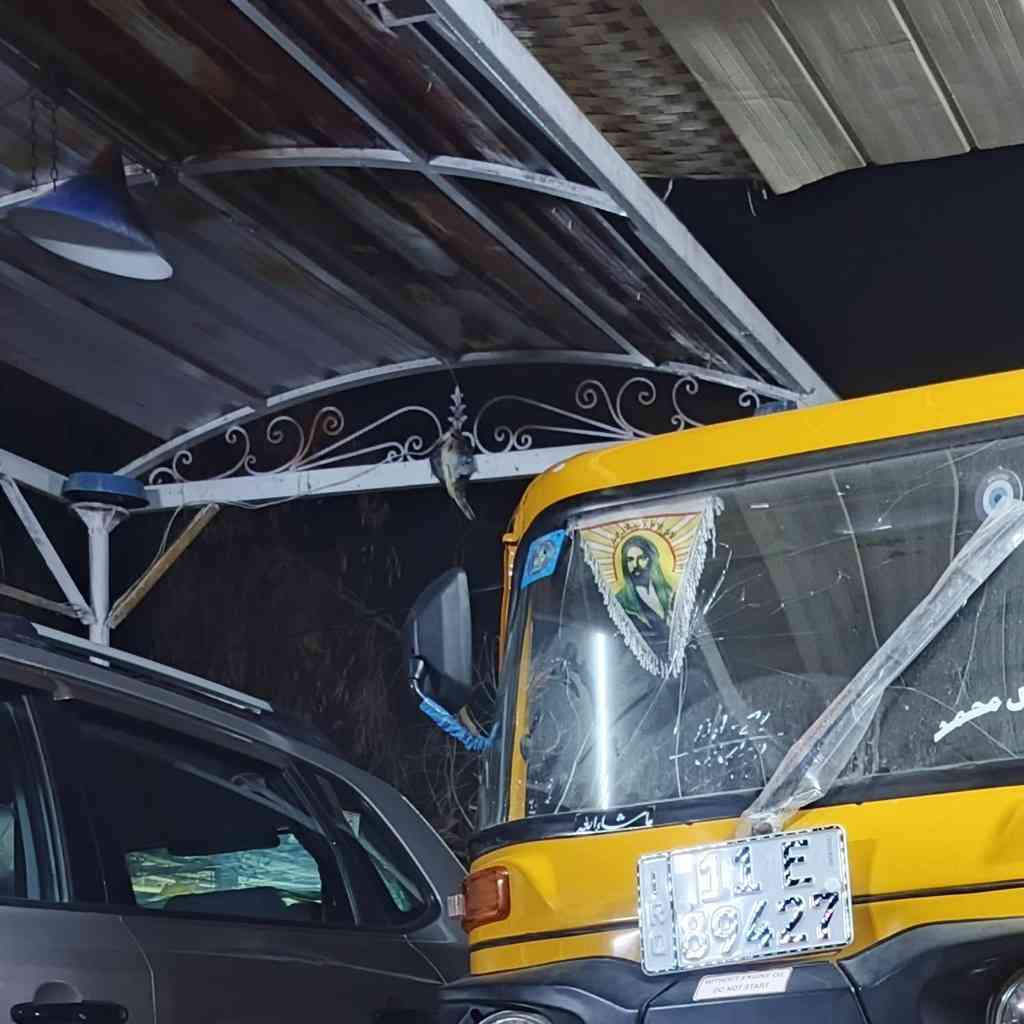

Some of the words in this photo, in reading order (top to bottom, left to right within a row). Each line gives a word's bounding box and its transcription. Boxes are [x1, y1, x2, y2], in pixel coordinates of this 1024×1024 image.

[933, 696, 1002, 743] محمد
[782, 839, 814, 887] E
[679, 891, 840, 960] 89427
